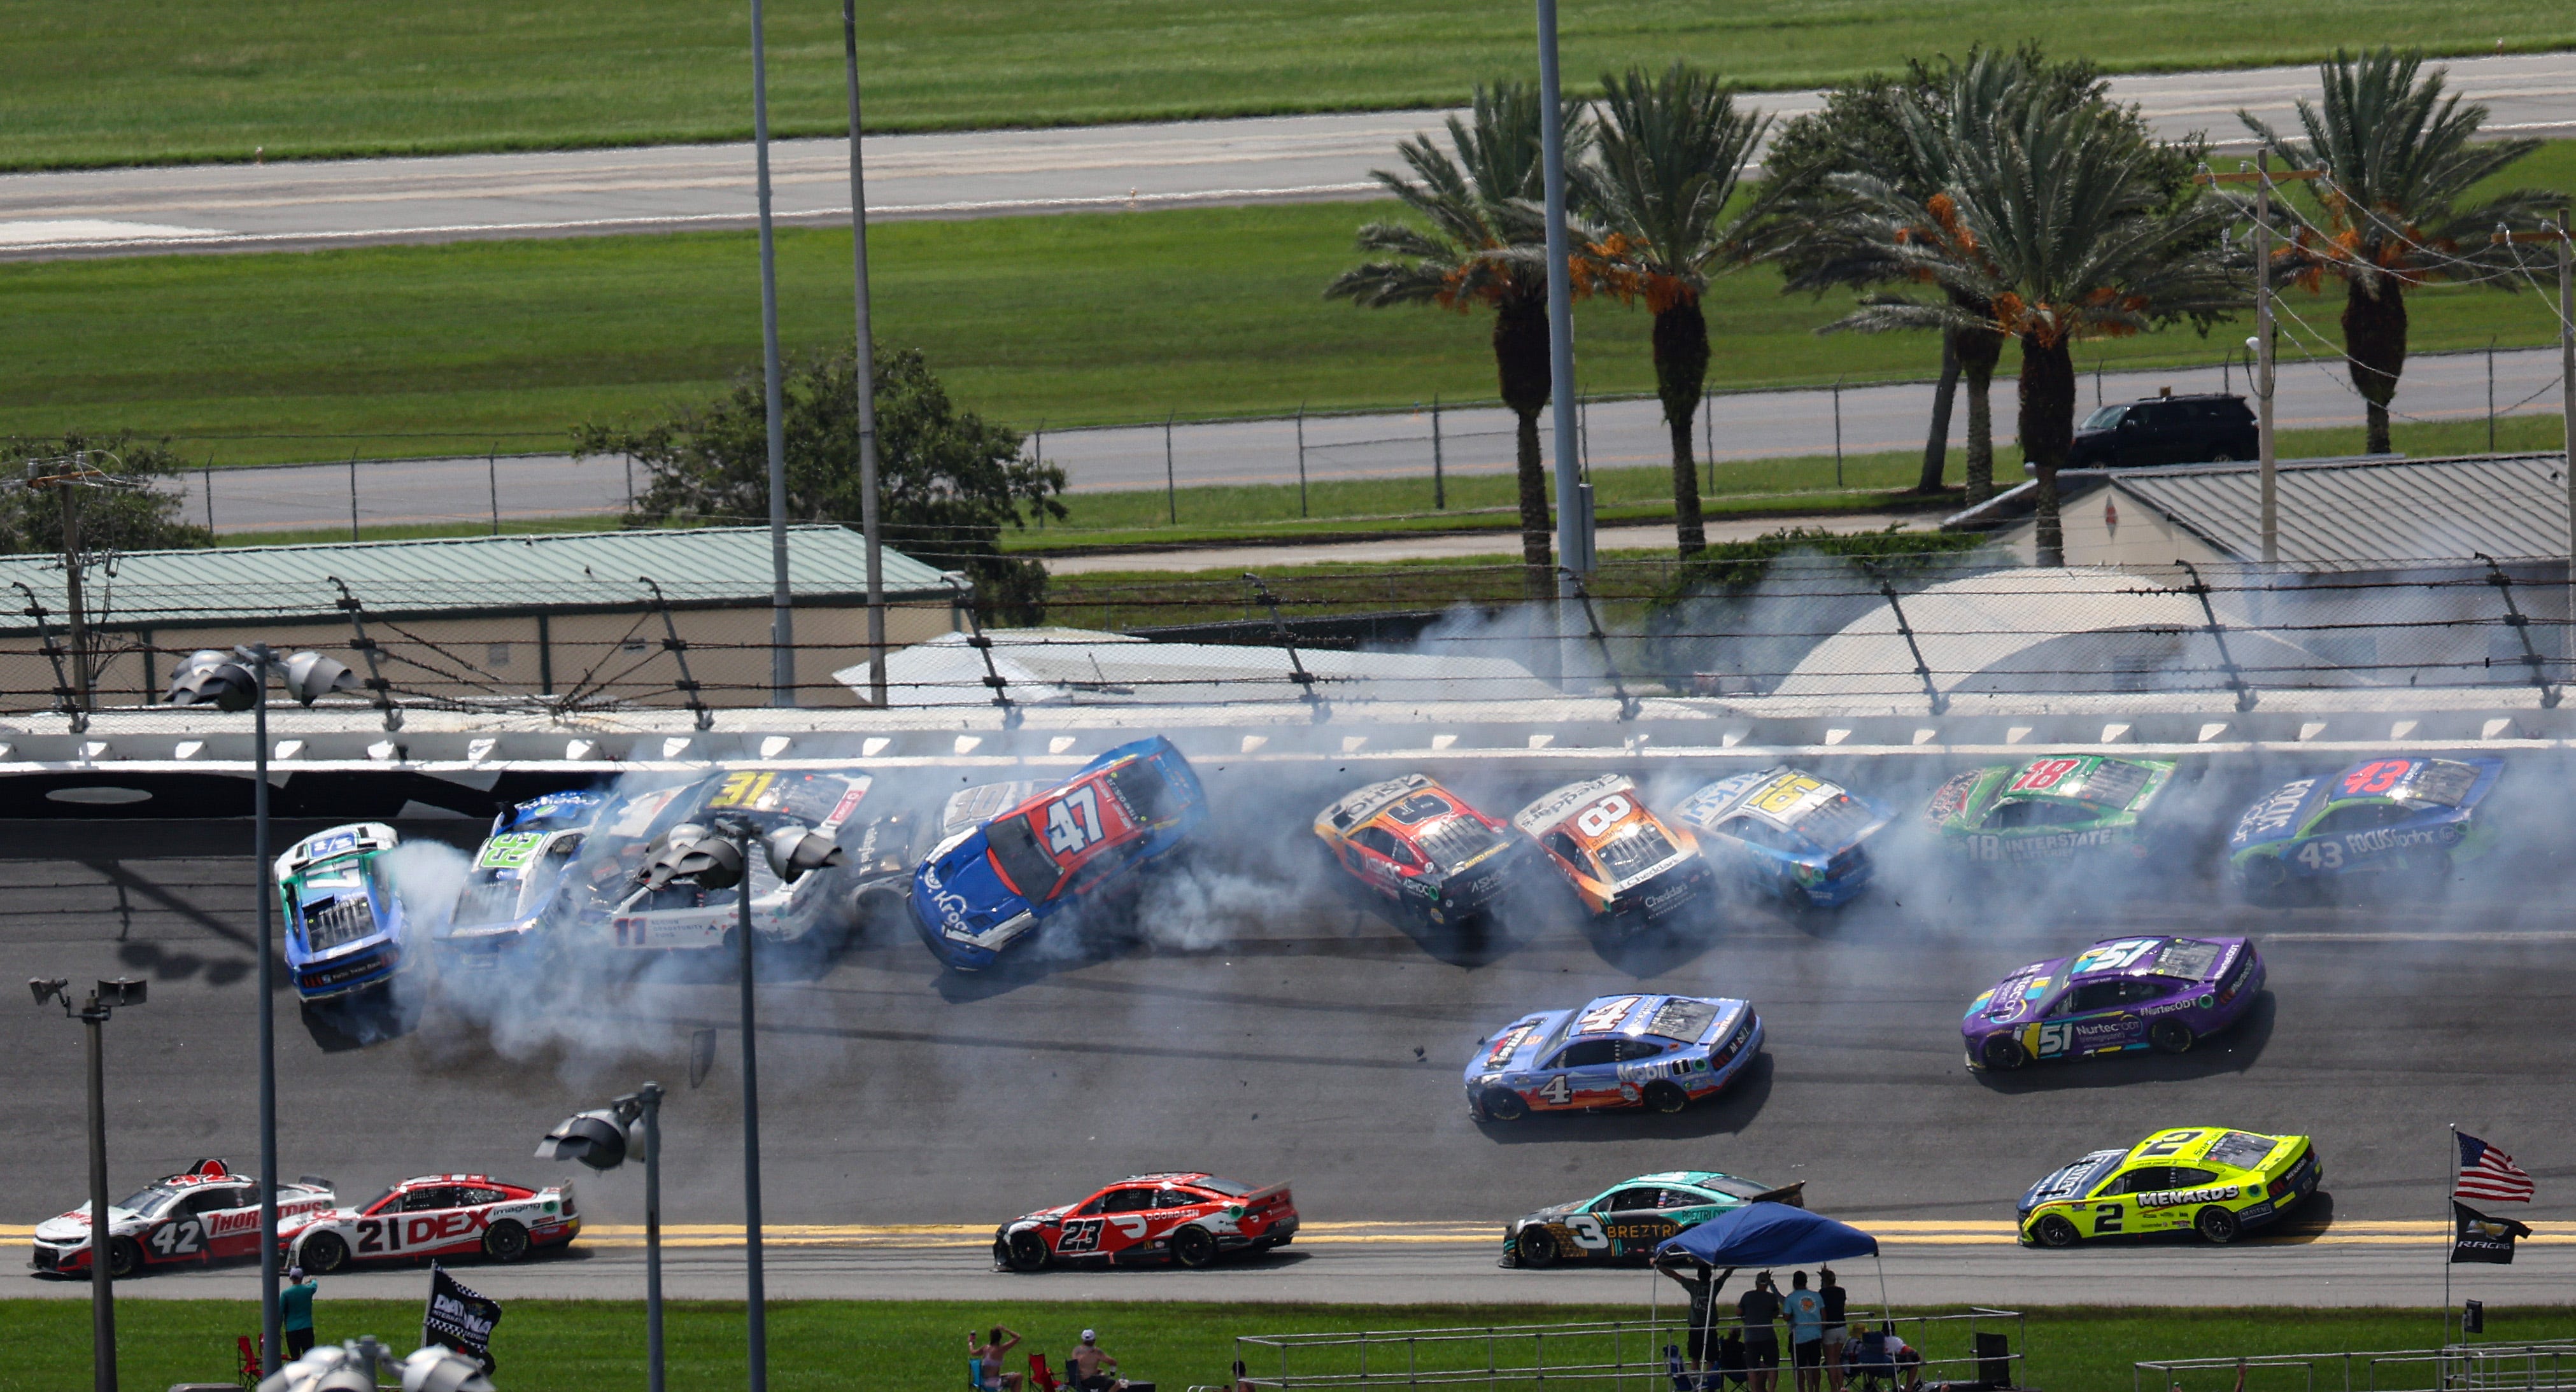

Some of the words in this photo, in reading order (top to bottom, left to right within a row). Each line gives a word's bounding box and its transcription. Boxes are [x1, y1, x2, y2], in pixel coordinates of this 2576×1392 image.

[709, 771, 776, 807] 31
[2008, 758, 2081, 792] 18
[2344, 760, 2410, 794] 43
[1747, 774, 1823, 813] 16
[1047, 784, 1105, 855] 47
[1578, 794, 1632, 837] 8
[1967, 834, 1999, 861] 18
[2006, 828, 2113, 852] INTERSTATE
[2297, 842, 2344, 870] 43
[306, 859, 362, 889] 17
[614, 917, 647, 947] 11
[2083, 940, 2162, 973] 51
[1580, 996, 1644, 1032] 4
[2140, 998, 2197, 1016] #NurtecODT
[2039, 1022, 2072, 1055] 51
[2076, 1023, 2119, 1036] Nurtec
[1617, 1060, 1668, 1081] Mobil
[1674, 1058, 1688, 1076] 1
[1538, 1074, 1572, 1106] 4
[2137, 1132, 2204, 1158] 2
[2137, 1185, 2240, 1208] MENARDS
[208, 1201, 323, 1236] THORTONS
[357, 1218, 401, 1253] 21
[407, 1206, 495, 1245] DEX
[493, 1203, 541, 1216] imaging
[1056, 1217, 1106, 1253] 23
[1147, 1209, 1200, 1221] DOORDASH
[1564, 1214, 1609, 1249] 3
[1607, 1224, 1677, 1239] BREZTRI
[2094, 1203, 2124, 1233] 2
[152, 1221, 199, 1255] 42
[2458, 1241, 2511, 1250] RACING
